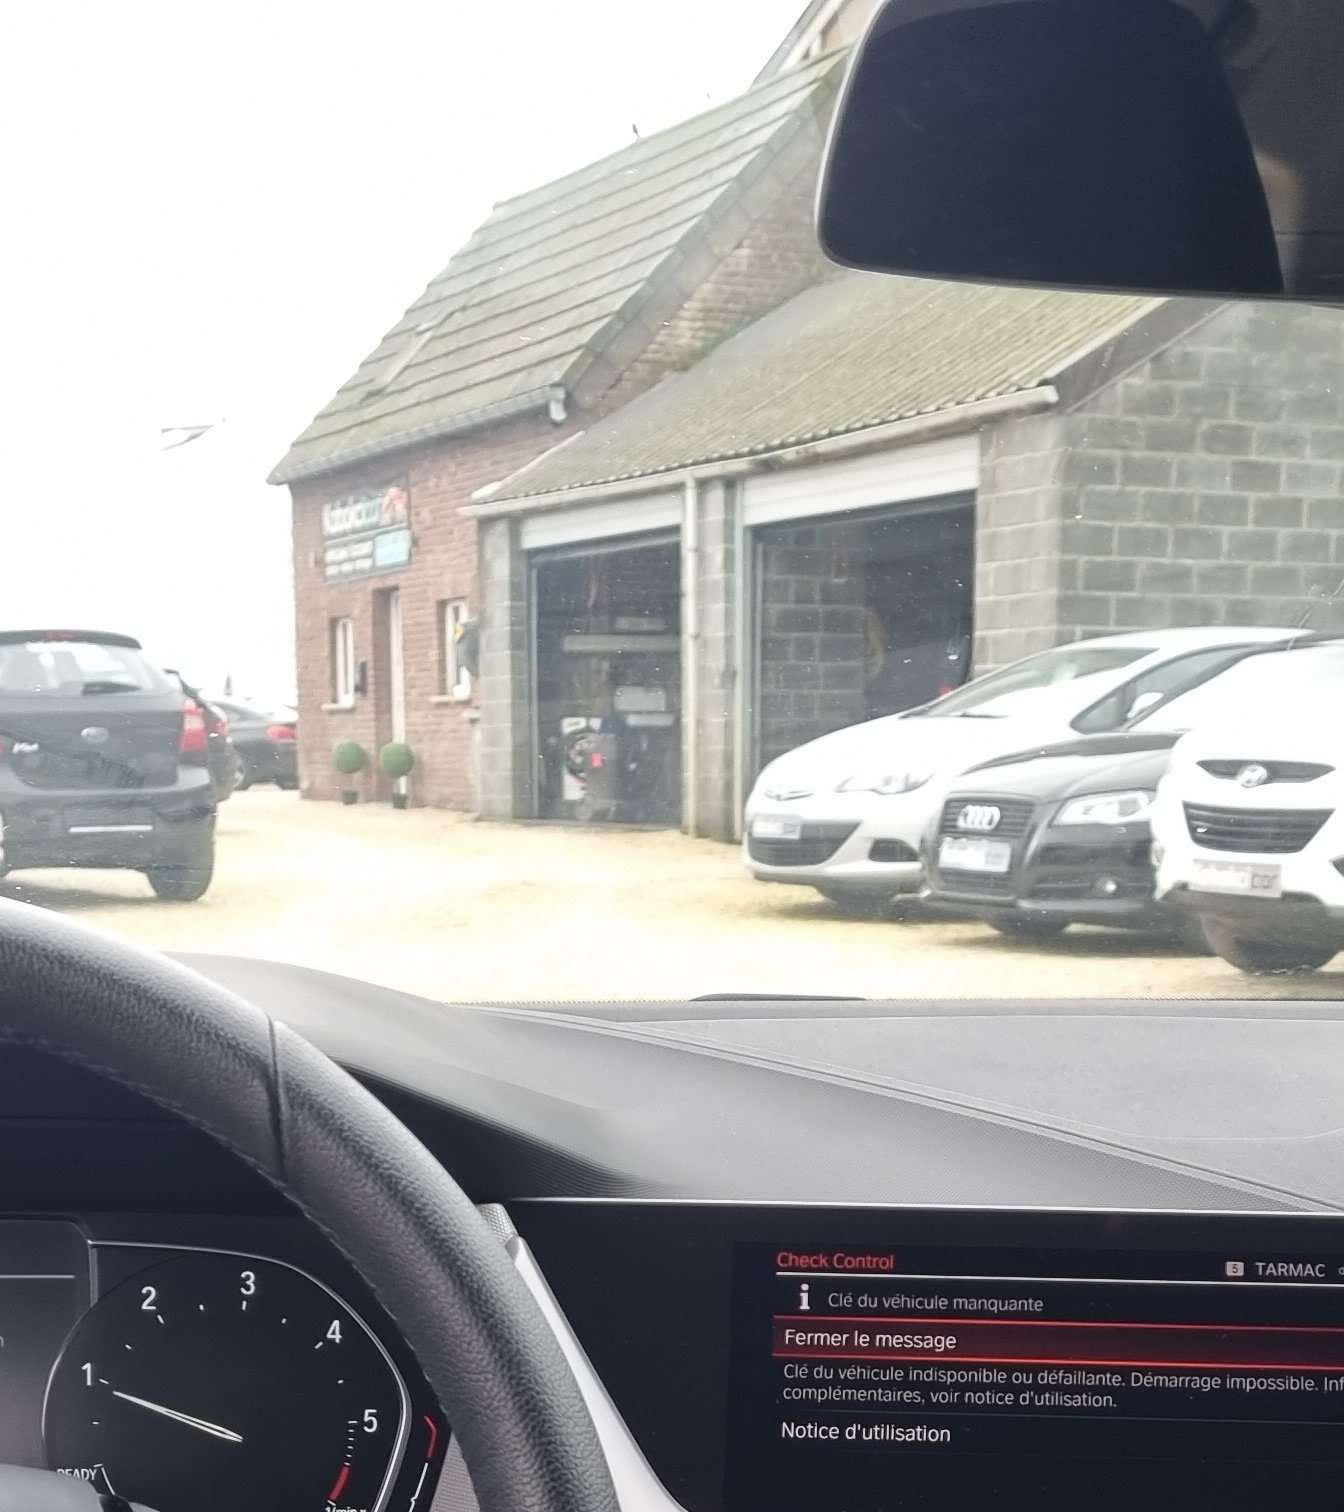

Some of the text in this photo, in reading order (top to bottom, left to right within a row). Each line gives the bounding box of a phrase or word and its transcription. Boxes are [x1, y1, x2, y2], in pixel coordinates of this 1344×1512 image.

[776, 1251, 894, 1270] Check Control
[1255, 1261, 1326, 1278] TARMAC
[240, 1270, 256, 1296] 3
[141, 1286, 157, 1310] 2
[828, 1292, 1044, 1314] Clé du véhicule manquante
[326, 1319, 343, 1344] 4
[785, 1328, 957, 1352] Fermer le message
[81, 1362, 92, 1386] 1
[783, 1363, 809, 1379] Clé
[813, 1364, 834, 1380] du
[838, 1364, 904, 1382] véhicule
[908, 1366, 1008, 1385] indisponible
[1011, 1371, 1033, 1385] ou
[1037, 1369, 1126, 1387] défaillante.
[1130, 1371, 1222, 1392] Démarrage
[1226, 1374, 1319, 1393] impossible.
[782, 1385, 1117, 1408] complémentaires, voir notice d'utilisation.
[363, 1408, 378, 1433] 5
[781, 1421, 951, 1442] Notice d'utilisation
